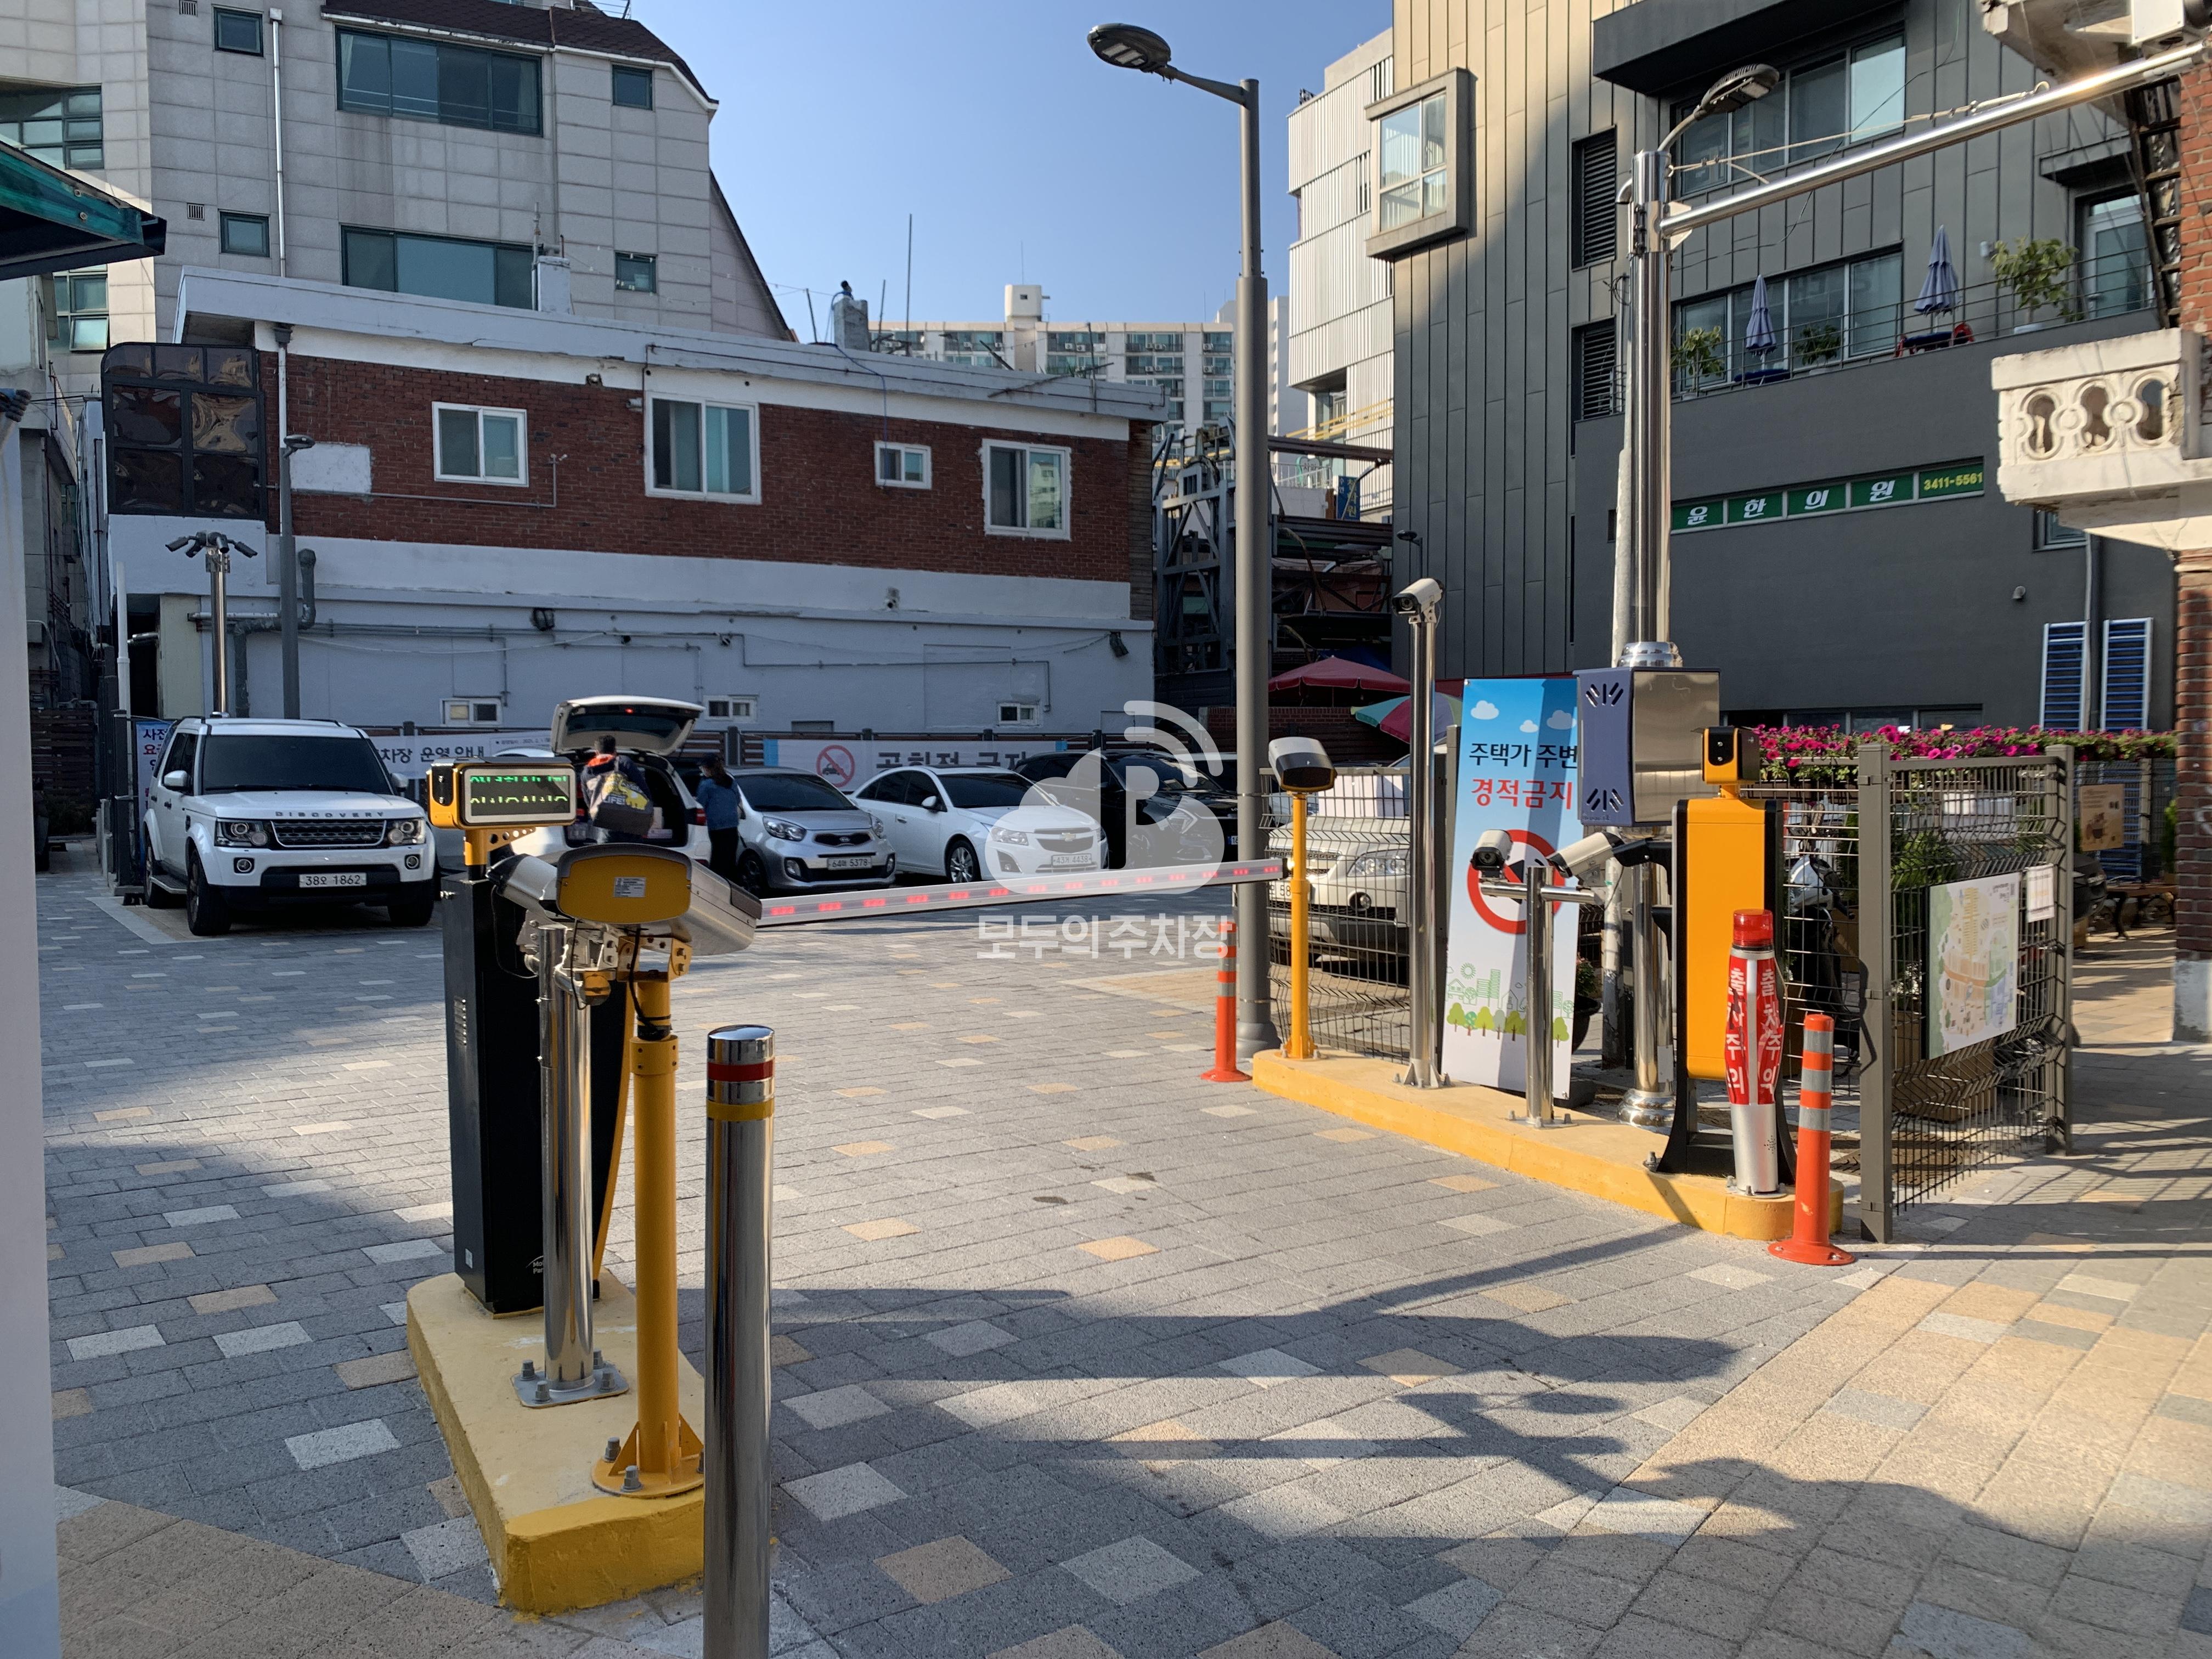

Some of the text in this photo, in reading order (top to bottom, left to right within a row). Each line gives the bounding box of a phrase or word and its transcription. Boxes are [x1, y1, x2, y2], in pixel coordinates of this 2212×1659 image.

[1923, 472, 1983, 490] 3411-5561
[379, 748, 413, 763] 차장
[420, 747, 450, 762] 운영
[1469, 743, 1578, 769] 주택가 주변
[1471, 778, 1573, 810] 경적금지
[305, 875, 361, 885] 38오 1862
